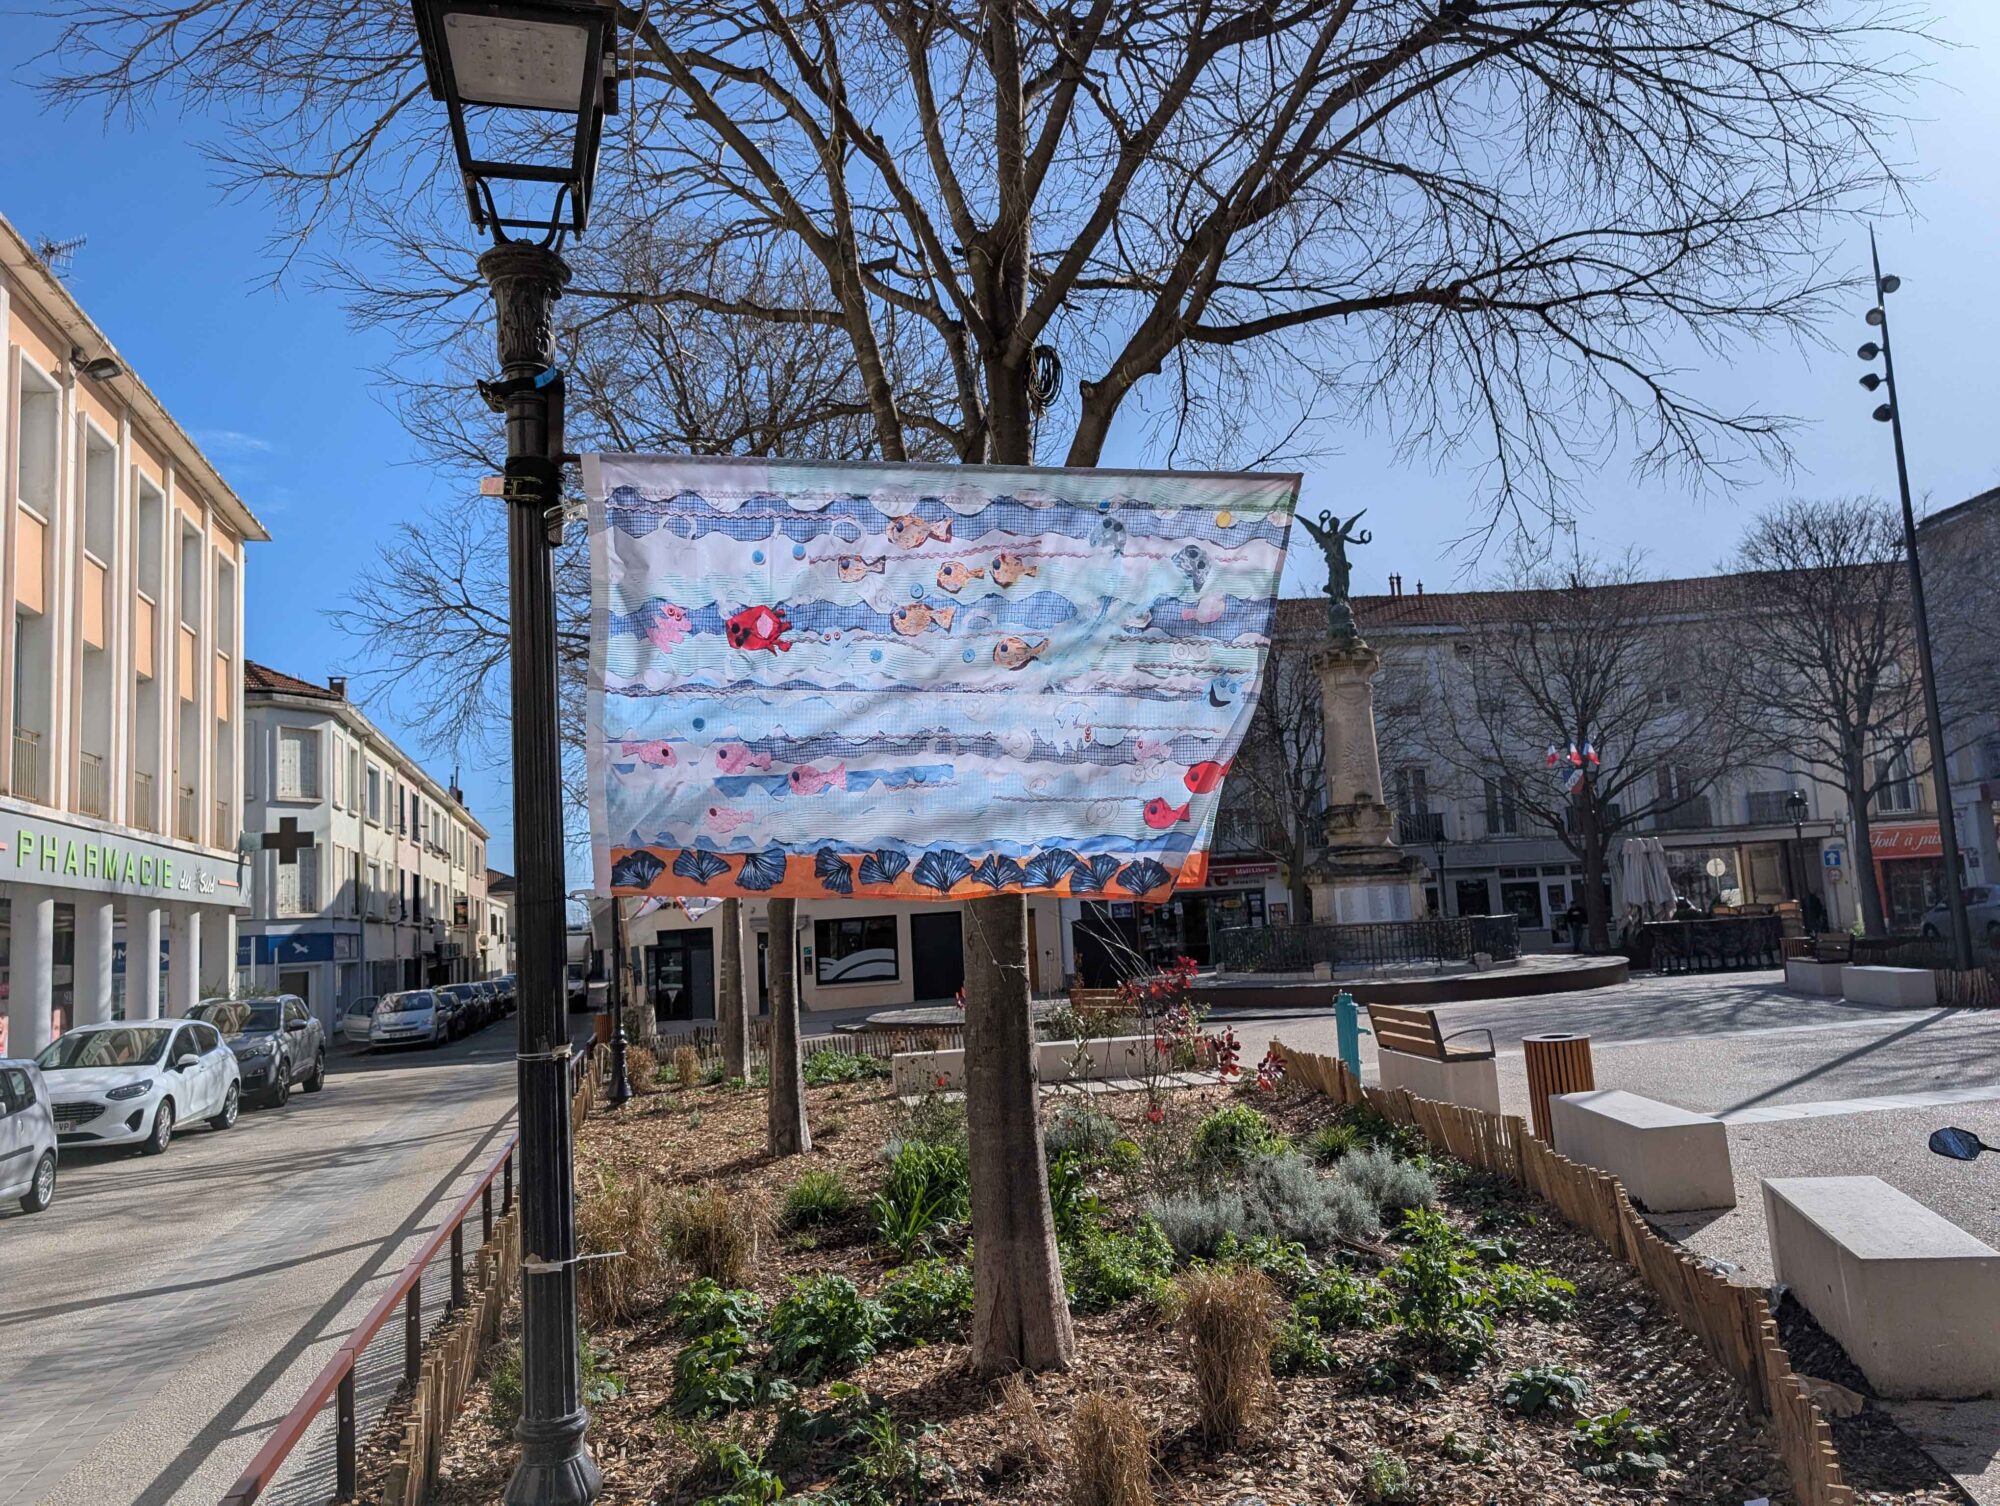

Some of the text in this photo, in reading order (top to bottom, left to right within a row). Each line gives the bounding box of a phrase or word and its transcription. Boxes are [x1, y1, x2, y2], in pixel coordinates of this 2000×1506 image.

[17, 830, 215, 894] PHARMACIE du Sud
